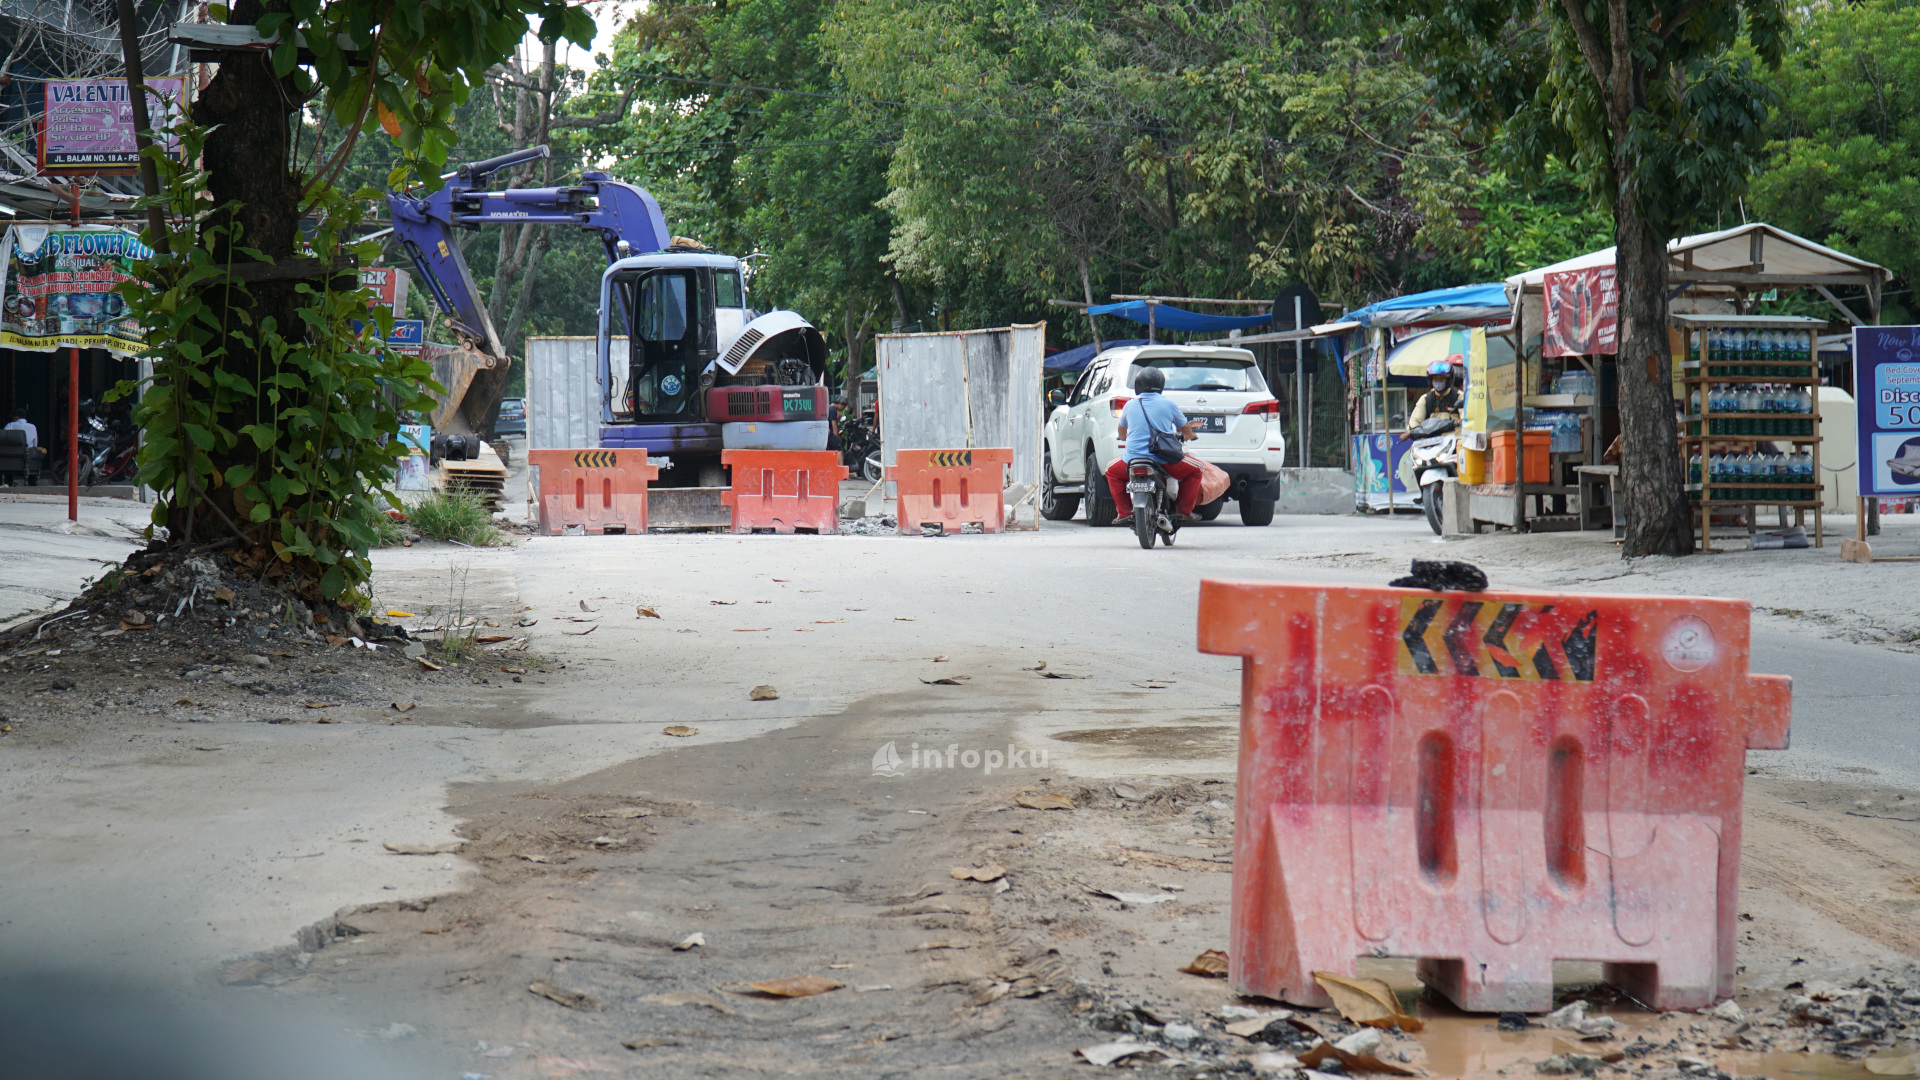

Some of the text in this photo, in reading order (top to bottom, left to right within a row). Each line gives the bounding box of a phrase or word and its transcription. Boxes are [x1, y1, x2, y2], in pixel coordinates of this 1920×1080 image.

[51, 115, 82, 123] Pulsa
[51, 124, 96, 132] HP Baru
[51, 133, 111, 142] Service HP
[66, 154, 92, 162] BALAM
[63, 234, 125, 256] FLOWER
[74, 271, 100, 282] CACING
[1878, 332, 1908, 350] Now
[1885, 365, 1901, 374] Bed
[1881, 388, 1920, 404] Disc
